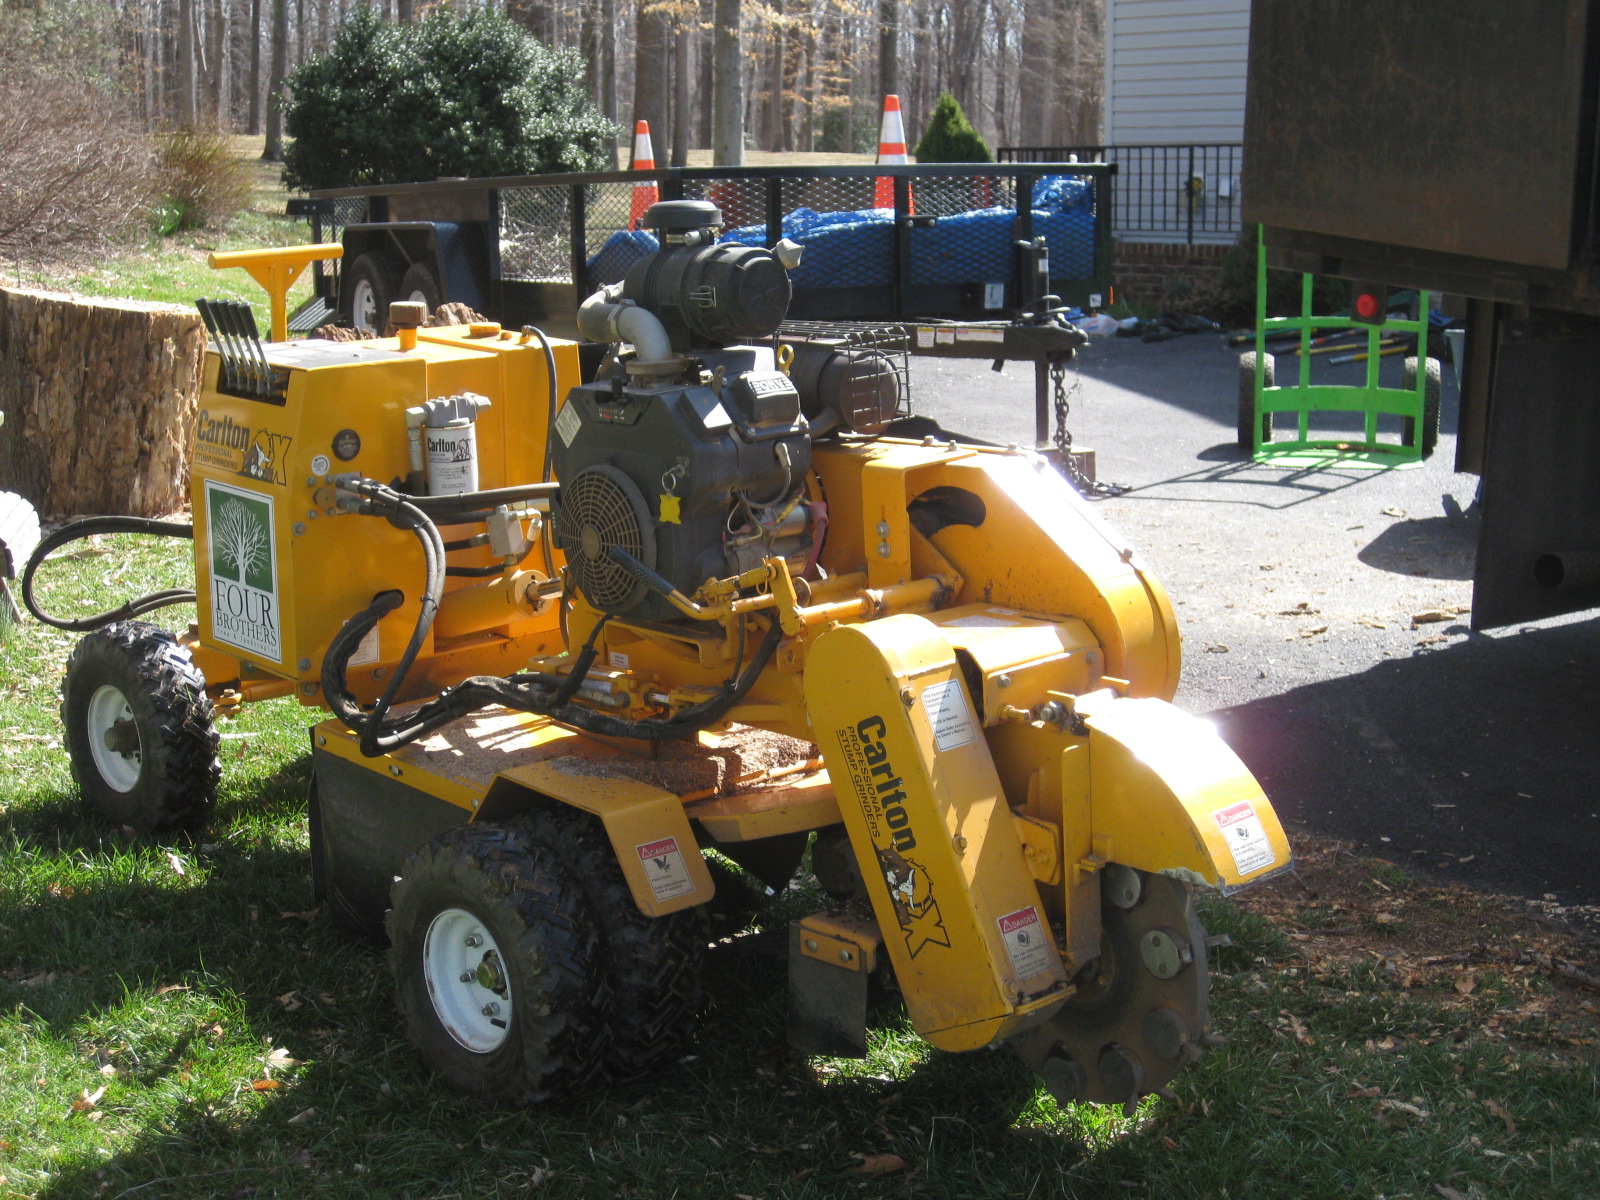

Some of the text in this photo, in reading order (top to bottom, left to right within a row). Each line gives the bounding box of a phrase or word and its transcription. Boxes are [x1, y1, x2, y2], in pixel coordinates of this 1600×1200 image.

[760, 378, 785, 391] OHV
[197, 409, 250, 452] Carlton
[195, 442, 233, 459] PROFESSIONAL
[427, 438, 456, 453] Carlton
[195, 452, 238, 470] STUMP GRINDERS
[214, 579, 275, 630] FOUR
[216, 609, 277, 647] BROTHERS
[847, 726, 885, 822] PROFESSIONAL
[838, 729, 881, 838] STUMP GRINDERS
[857, 715, 917, 852] Carlton
[1230, 808, 1254, 821] DANGER
[650, 844, 676, 856] DANGER
[1012, 914, 1036, 929] DANGER
